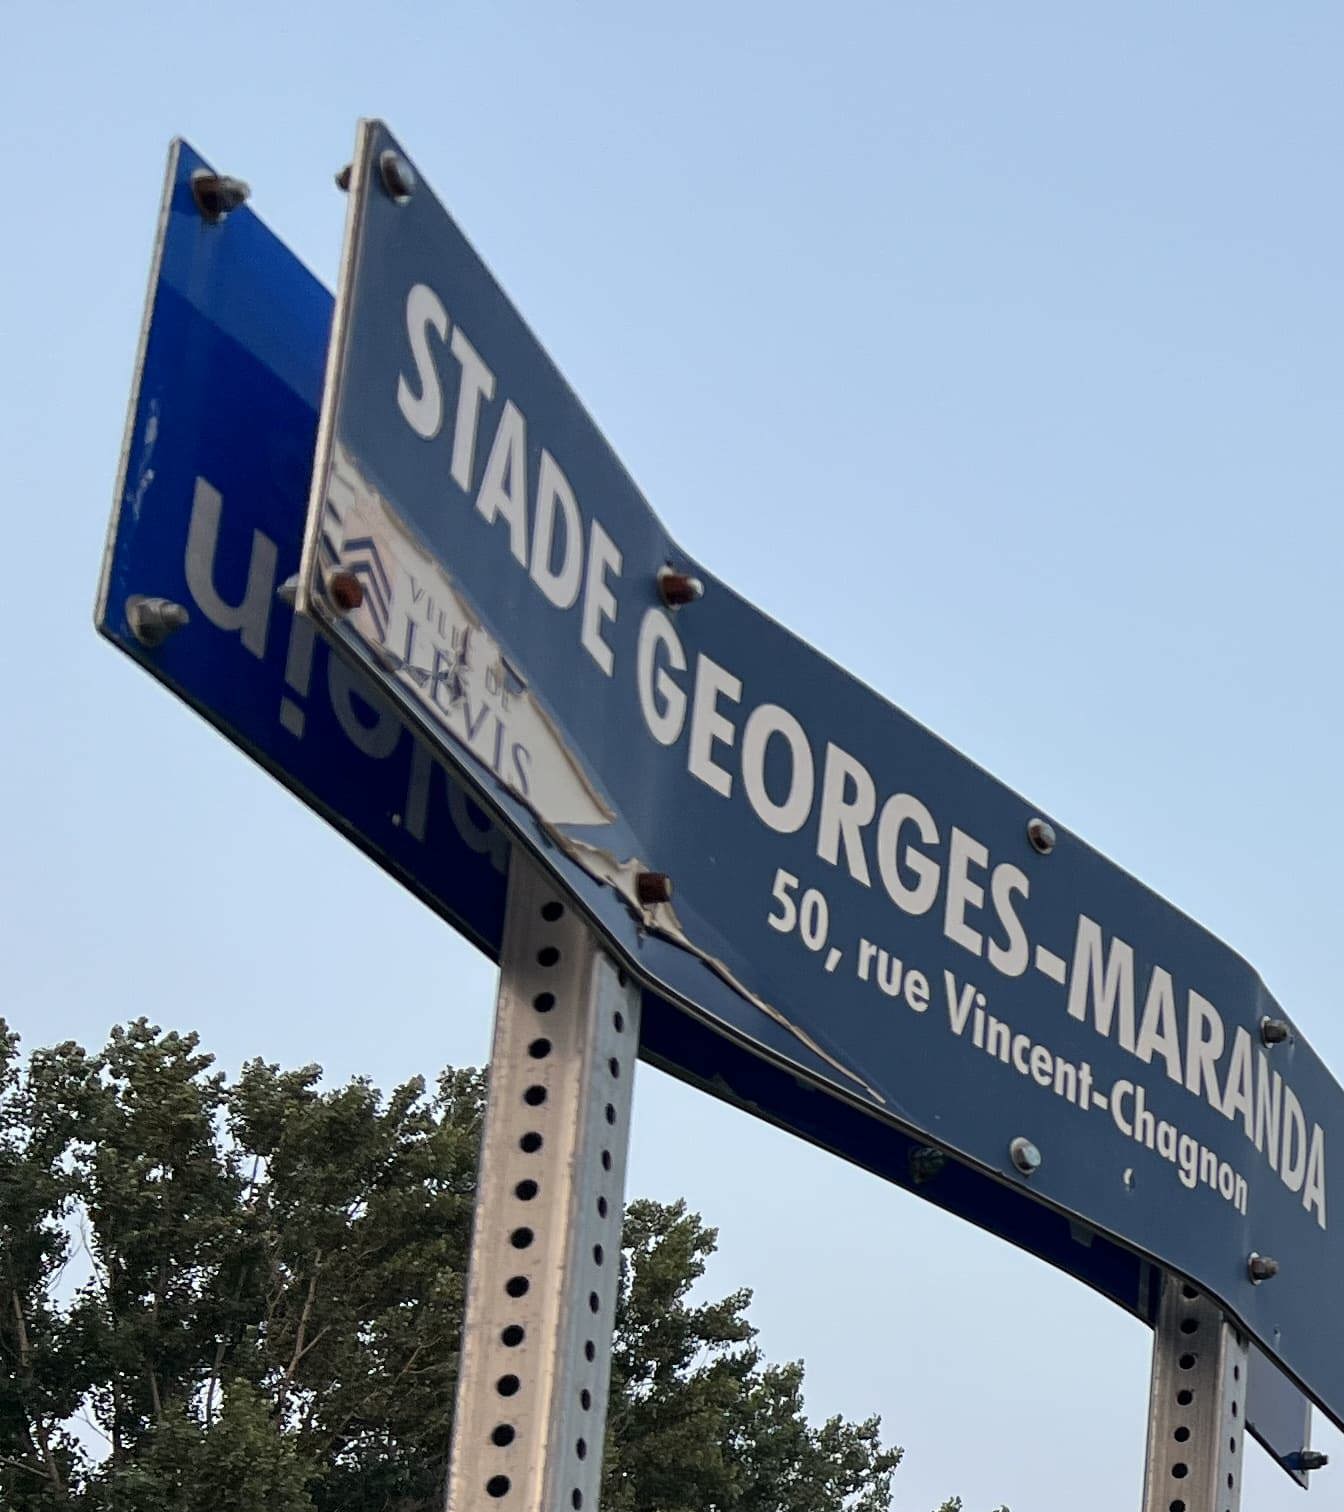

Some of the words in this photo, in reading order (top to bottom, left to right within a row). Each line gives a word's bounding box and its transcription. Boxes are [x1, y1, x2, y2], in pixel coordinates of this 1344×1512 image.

[399, 284, 624, 677] STADE
[636, 606, 1327, 1230] GEORGES-MARANDA
[768, 868, 842, 972] 50,
[858, 938, 930, 1012] rue
[944, 969, 1248, 1215] Vincent-Chagnon
